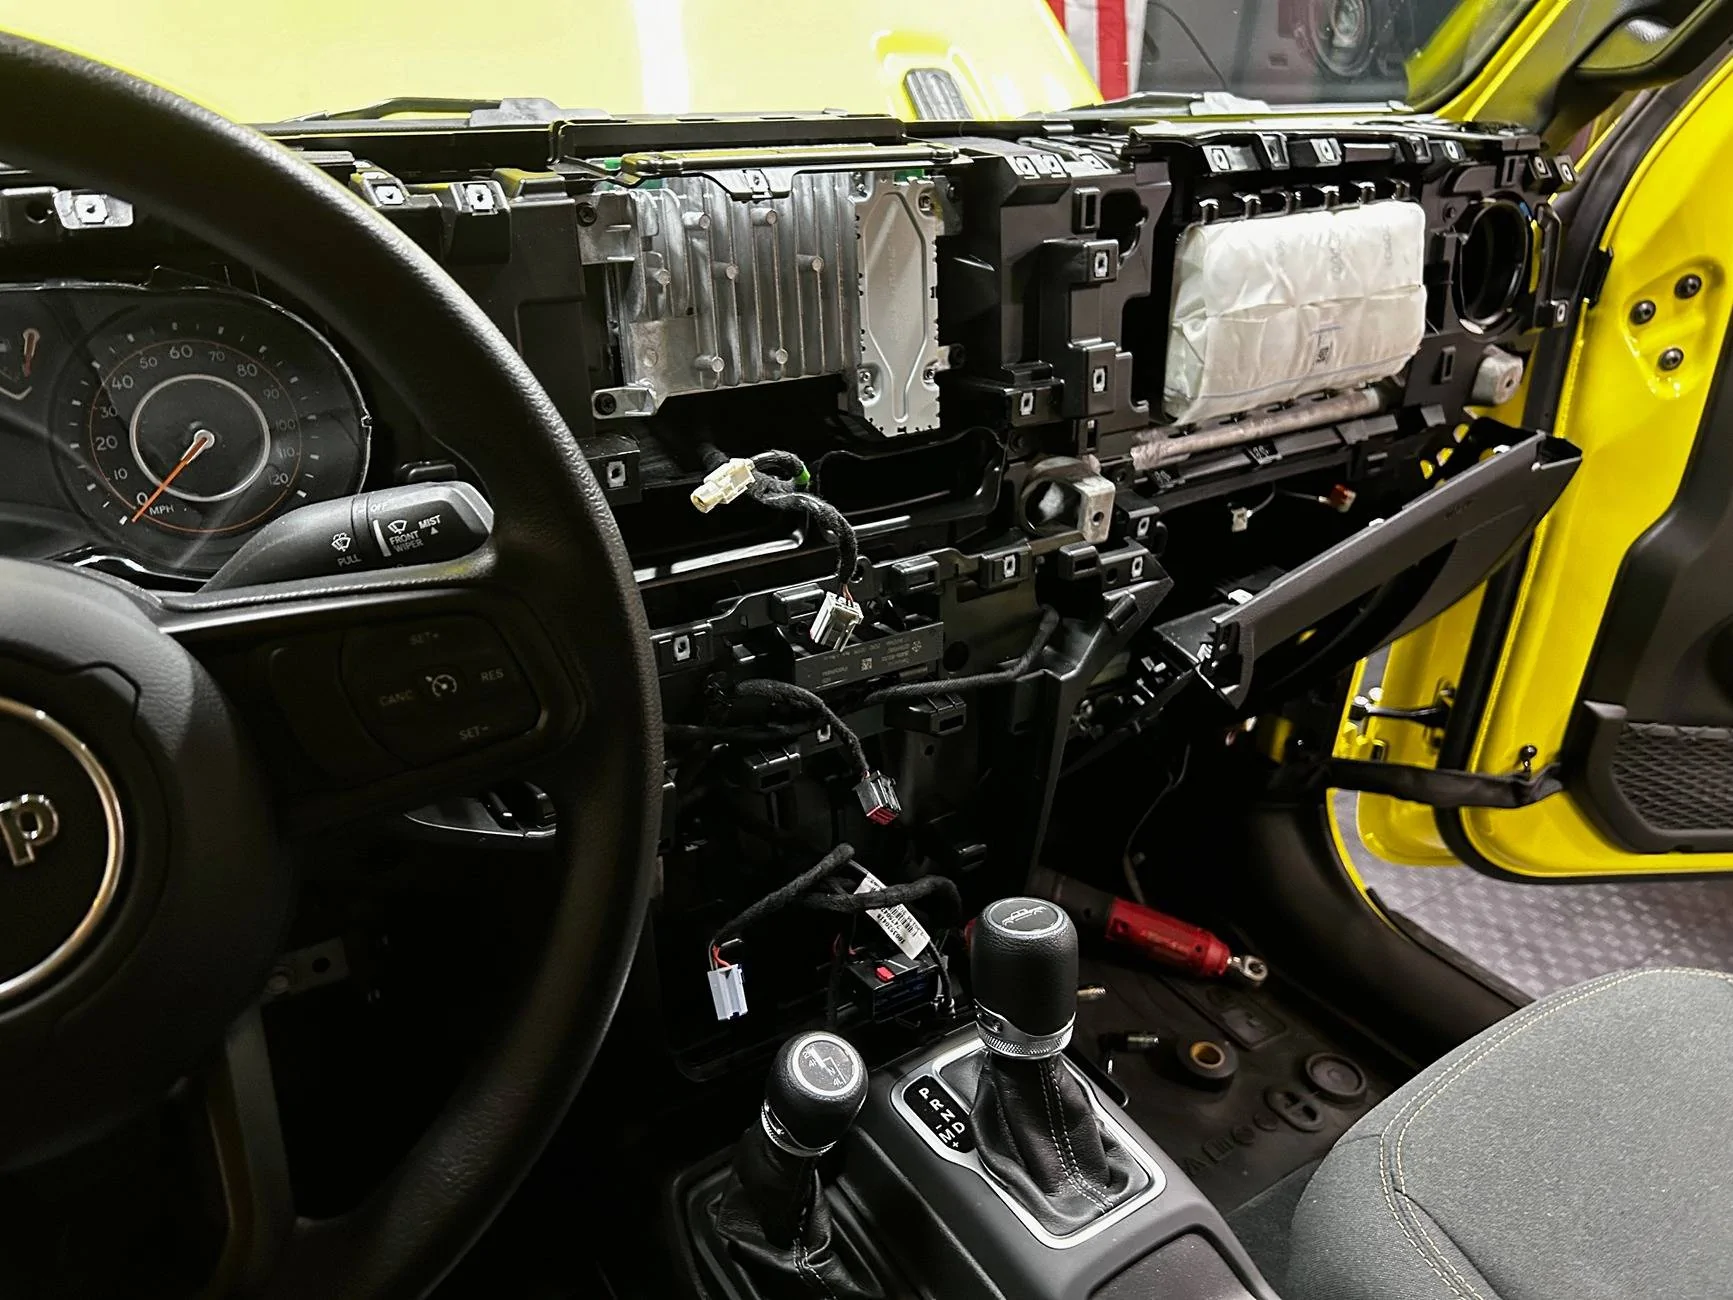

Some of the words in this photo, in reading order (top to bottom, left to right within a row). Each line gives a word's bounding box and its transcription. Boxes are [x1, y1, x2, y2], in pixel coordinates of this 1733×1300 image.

[168, 344, 194, 360] 60
[207, 350, 226, 362] 70
[139, 356, 158, 369] 50
[236, 364, 258, 378] 80
[111, 375, 135, 390] 40
[263, 387, 280, 400] 90
[99, 405, 119, 419] 30
[96, 436, 118, 451] 20
[114, 467, 128, 480] 10
[268, 472, 290, 485] 120
[149, 503, 175, 516] MPH
[418, 514, 442, 530] MIST
[388, 530, 420, 546] FRONT
[393, 538, 425, 553] WIPER
[337, 553, 363, 567] PULL
[480, 668, 505, 683] RES
[918, 1087, 930, 1100] P
[929, 1098, 945, 1111] R
[940, 1108, 956, 1122] N
[951, 1121, 966, 1135] D
[938, 1128, 956, 1143] M
